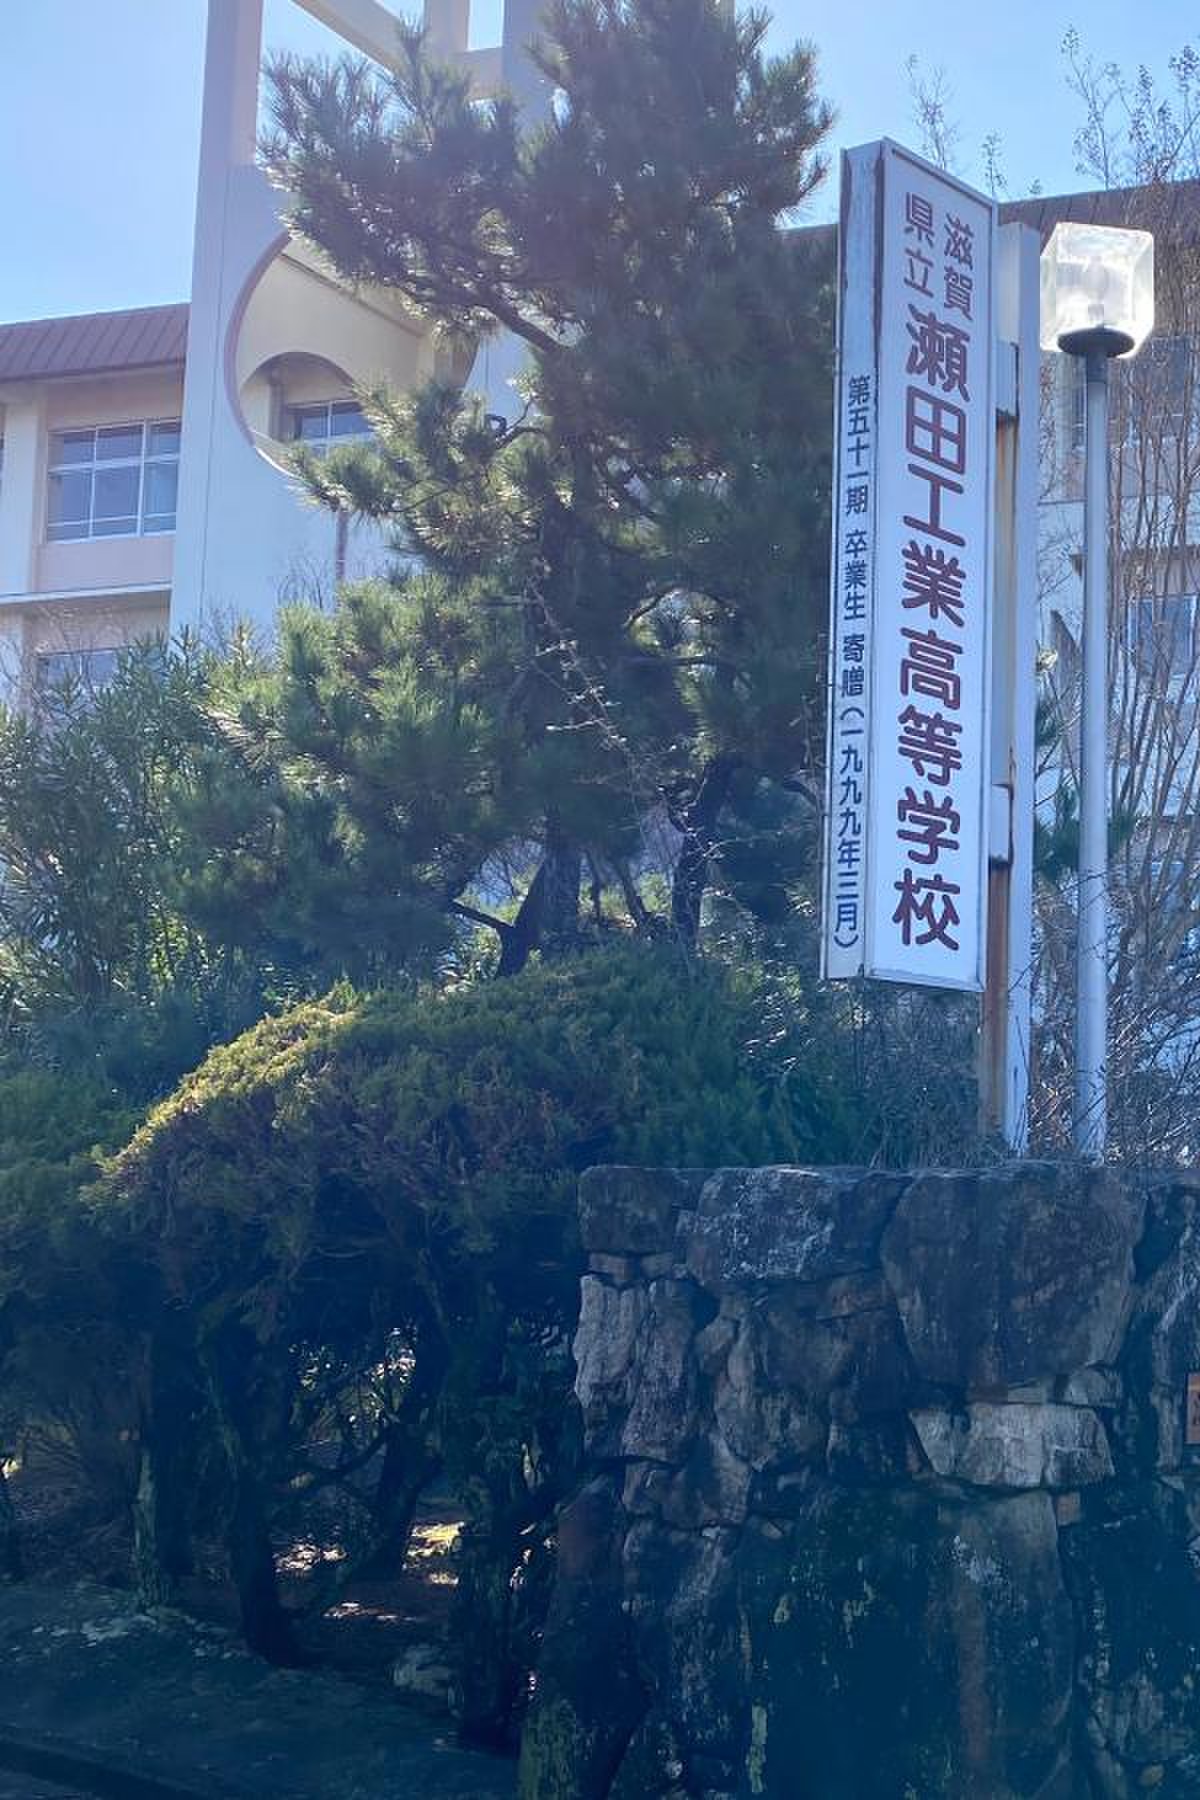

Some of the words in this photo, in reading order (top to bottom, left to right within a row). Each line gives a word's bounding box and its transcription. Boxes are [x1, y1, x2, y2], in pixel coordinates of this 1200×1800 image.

[904, 191, 934, 299] 県立
[943, 210, 975, 322] 滋賀
[845, 374, 871, 515] 第五十一期
[843, 527, 868, 621] 卒業生
[892, 303, 971, 952] 瀬田工業高等学校
